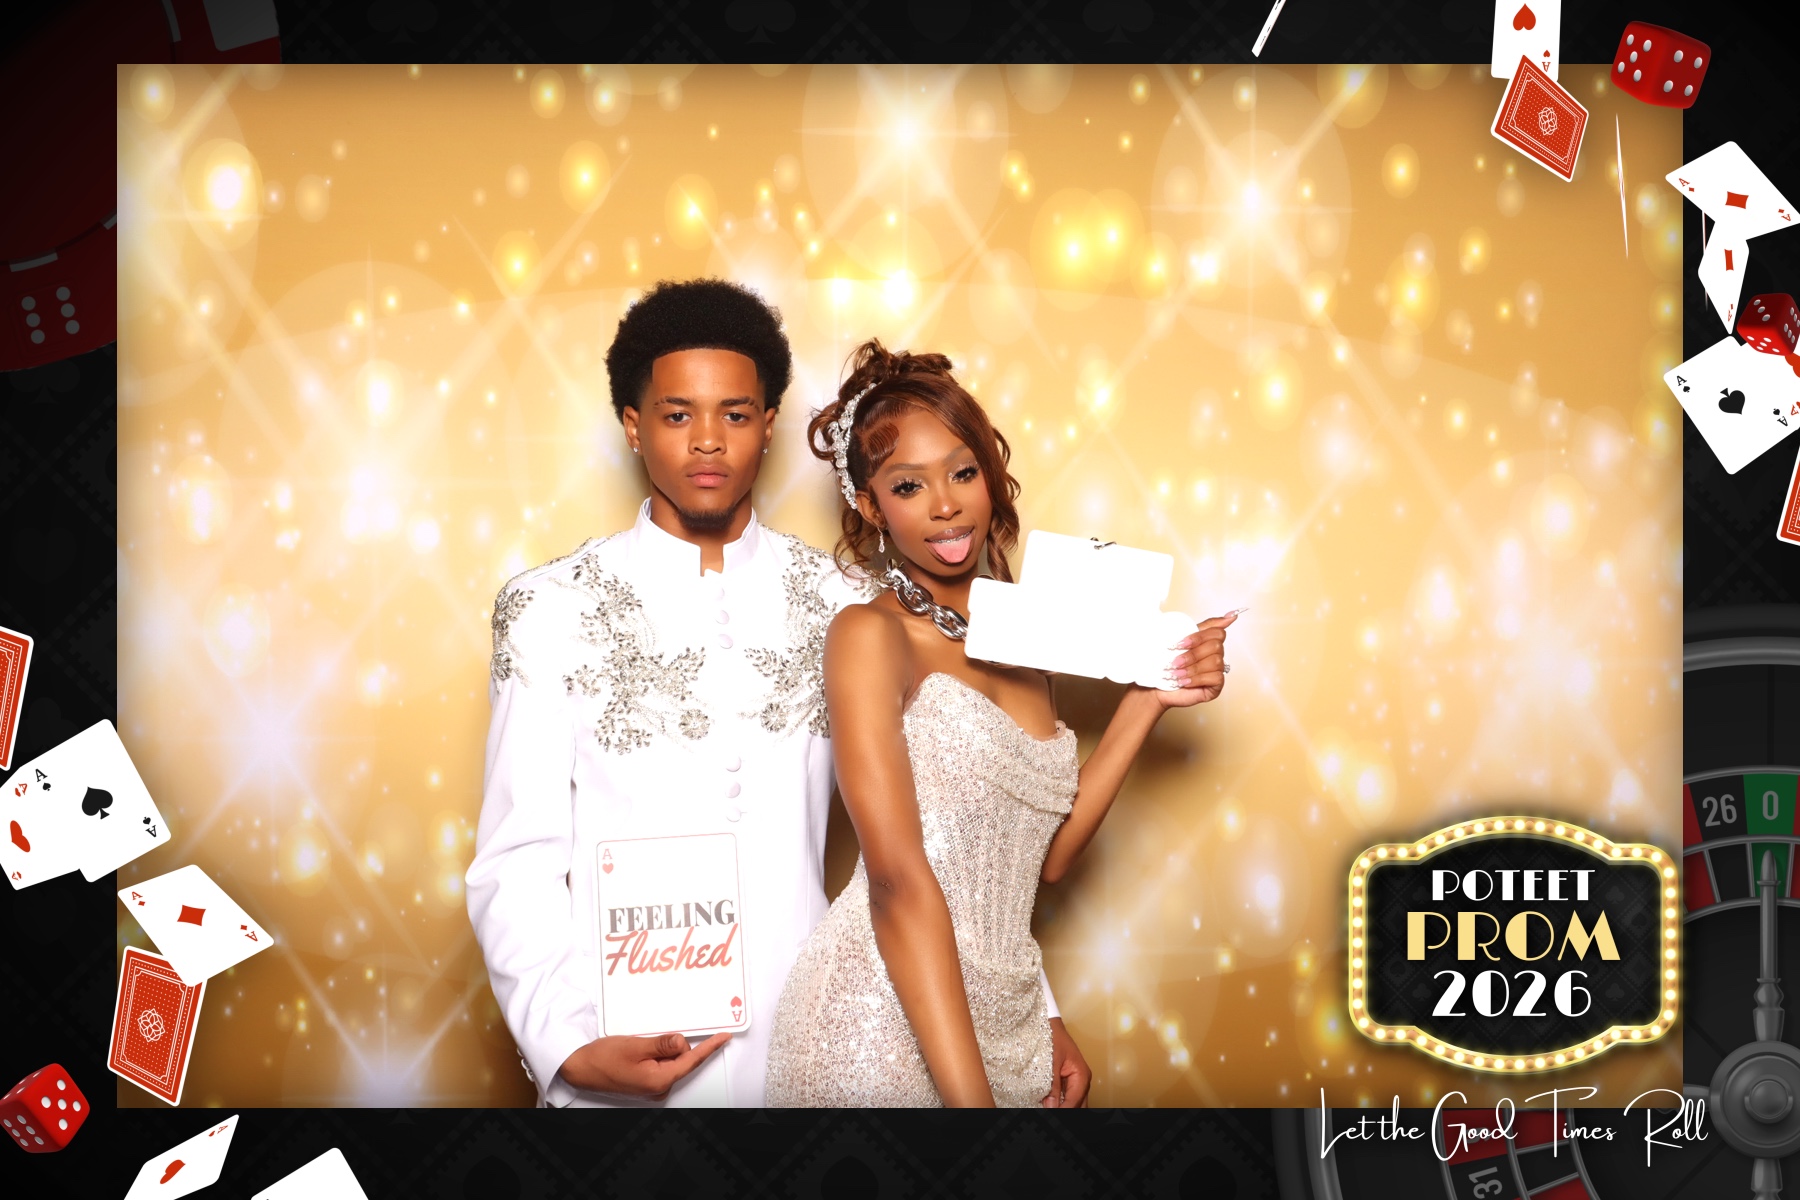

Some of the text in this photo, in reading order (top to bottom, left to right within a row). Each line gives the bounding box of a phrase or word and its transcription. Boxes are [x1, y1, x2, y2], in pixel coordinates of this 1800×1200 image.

[602, 848, 613, 860] A
[608, 899, 735, 933] FEELING
[605, 923, 738, 976] Flushed
[731, 1010, 743, 1022] A
